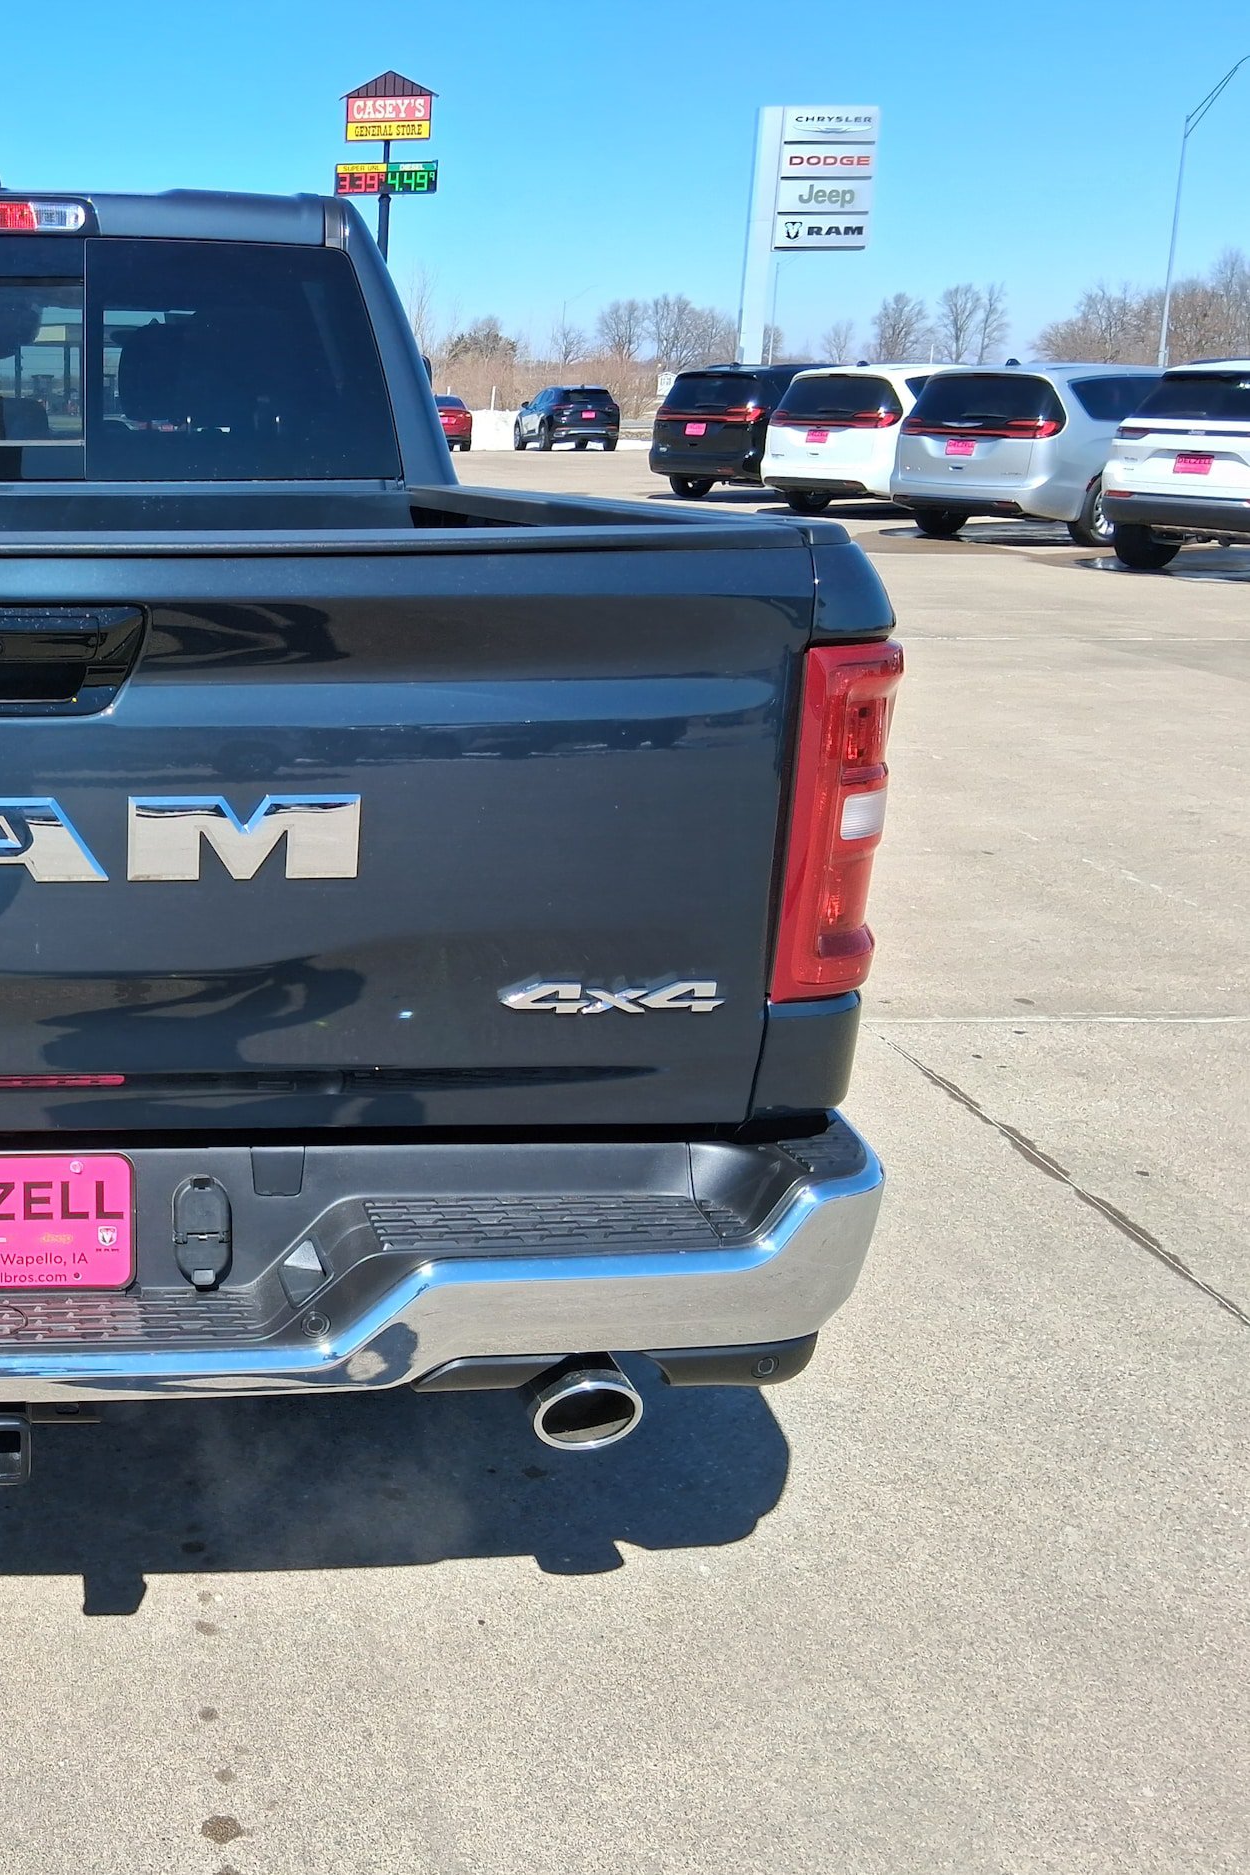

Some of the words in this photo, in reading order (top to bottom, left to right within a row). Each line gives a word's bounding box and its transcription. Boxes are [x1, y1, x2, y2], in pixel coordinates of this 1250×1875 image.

[353, 98, 425, 119] CASEY'S
[355, 125, 393, 137] GENERAL
[397, 124, 422, 136] STORE
[789, 156, 870, 166] DODGE
[798, 184, 855, 208] Jeep
[807, 226, 864, 236] RAM
[0, 1252, 67, 1267] Wapello,
[72, 1252, 88, 1264] IA
